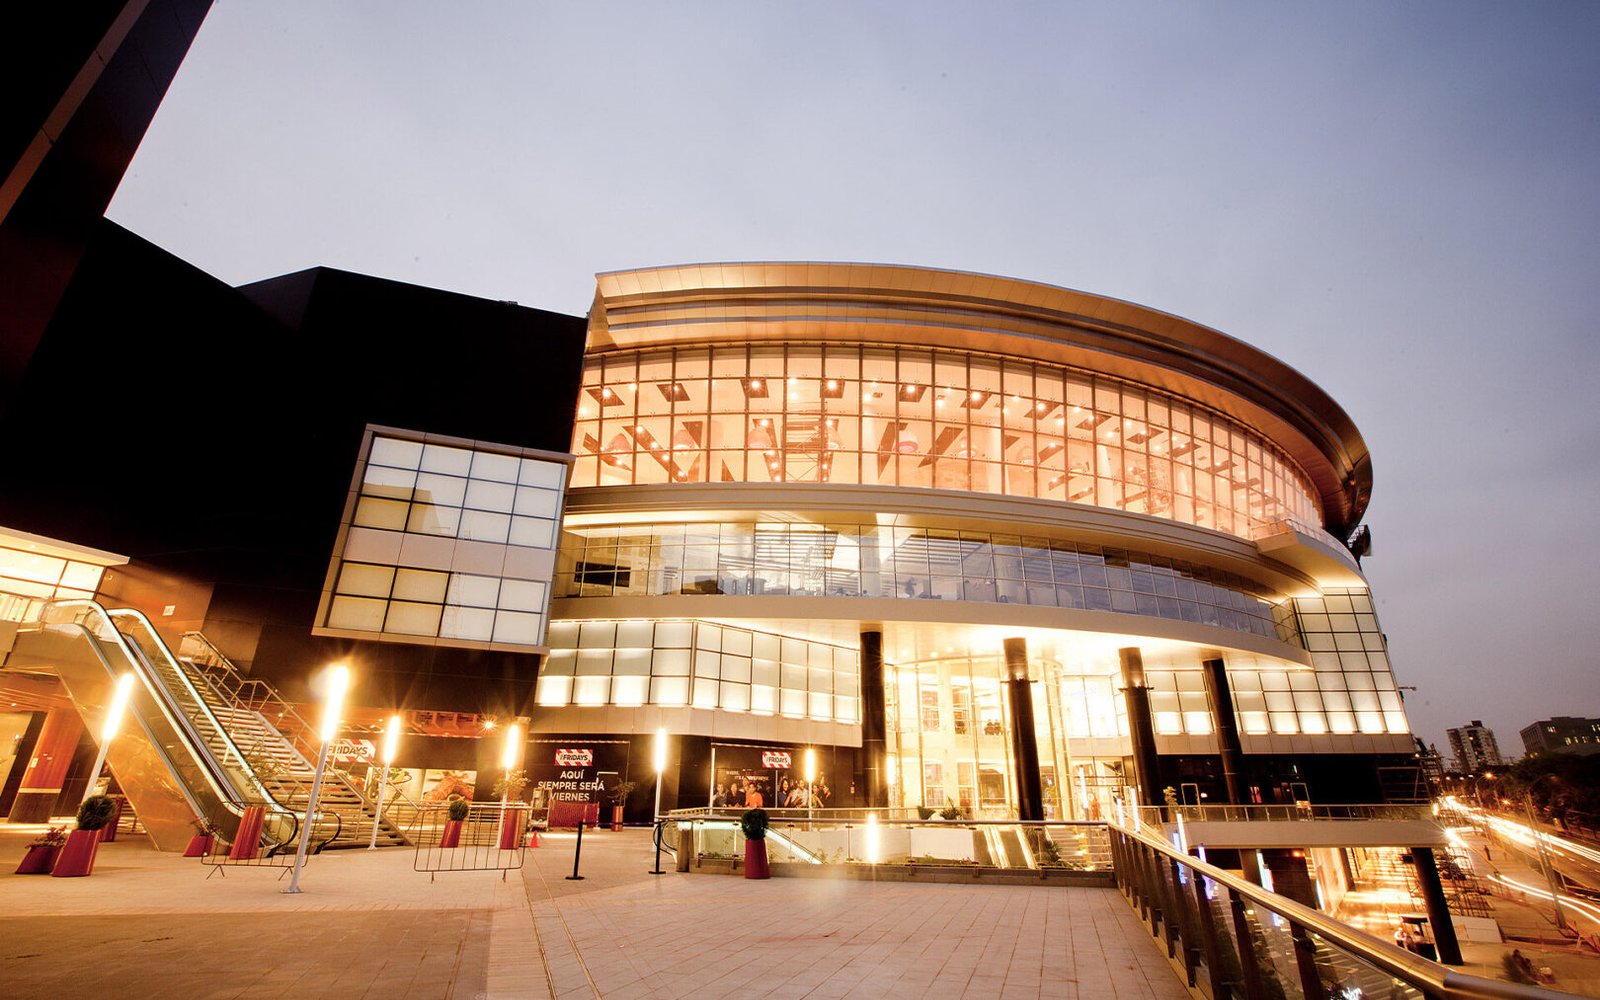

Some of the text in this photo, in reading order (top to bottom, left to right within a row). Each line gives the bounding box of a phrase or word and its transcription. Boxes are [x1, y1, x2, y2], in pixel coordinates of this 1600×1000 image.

[560, 769, 584, 779] AQUÍ
[538, 780, 605, 790] SIEMPRE SERÁ
[551, 793, 590, 801] VIERNES
